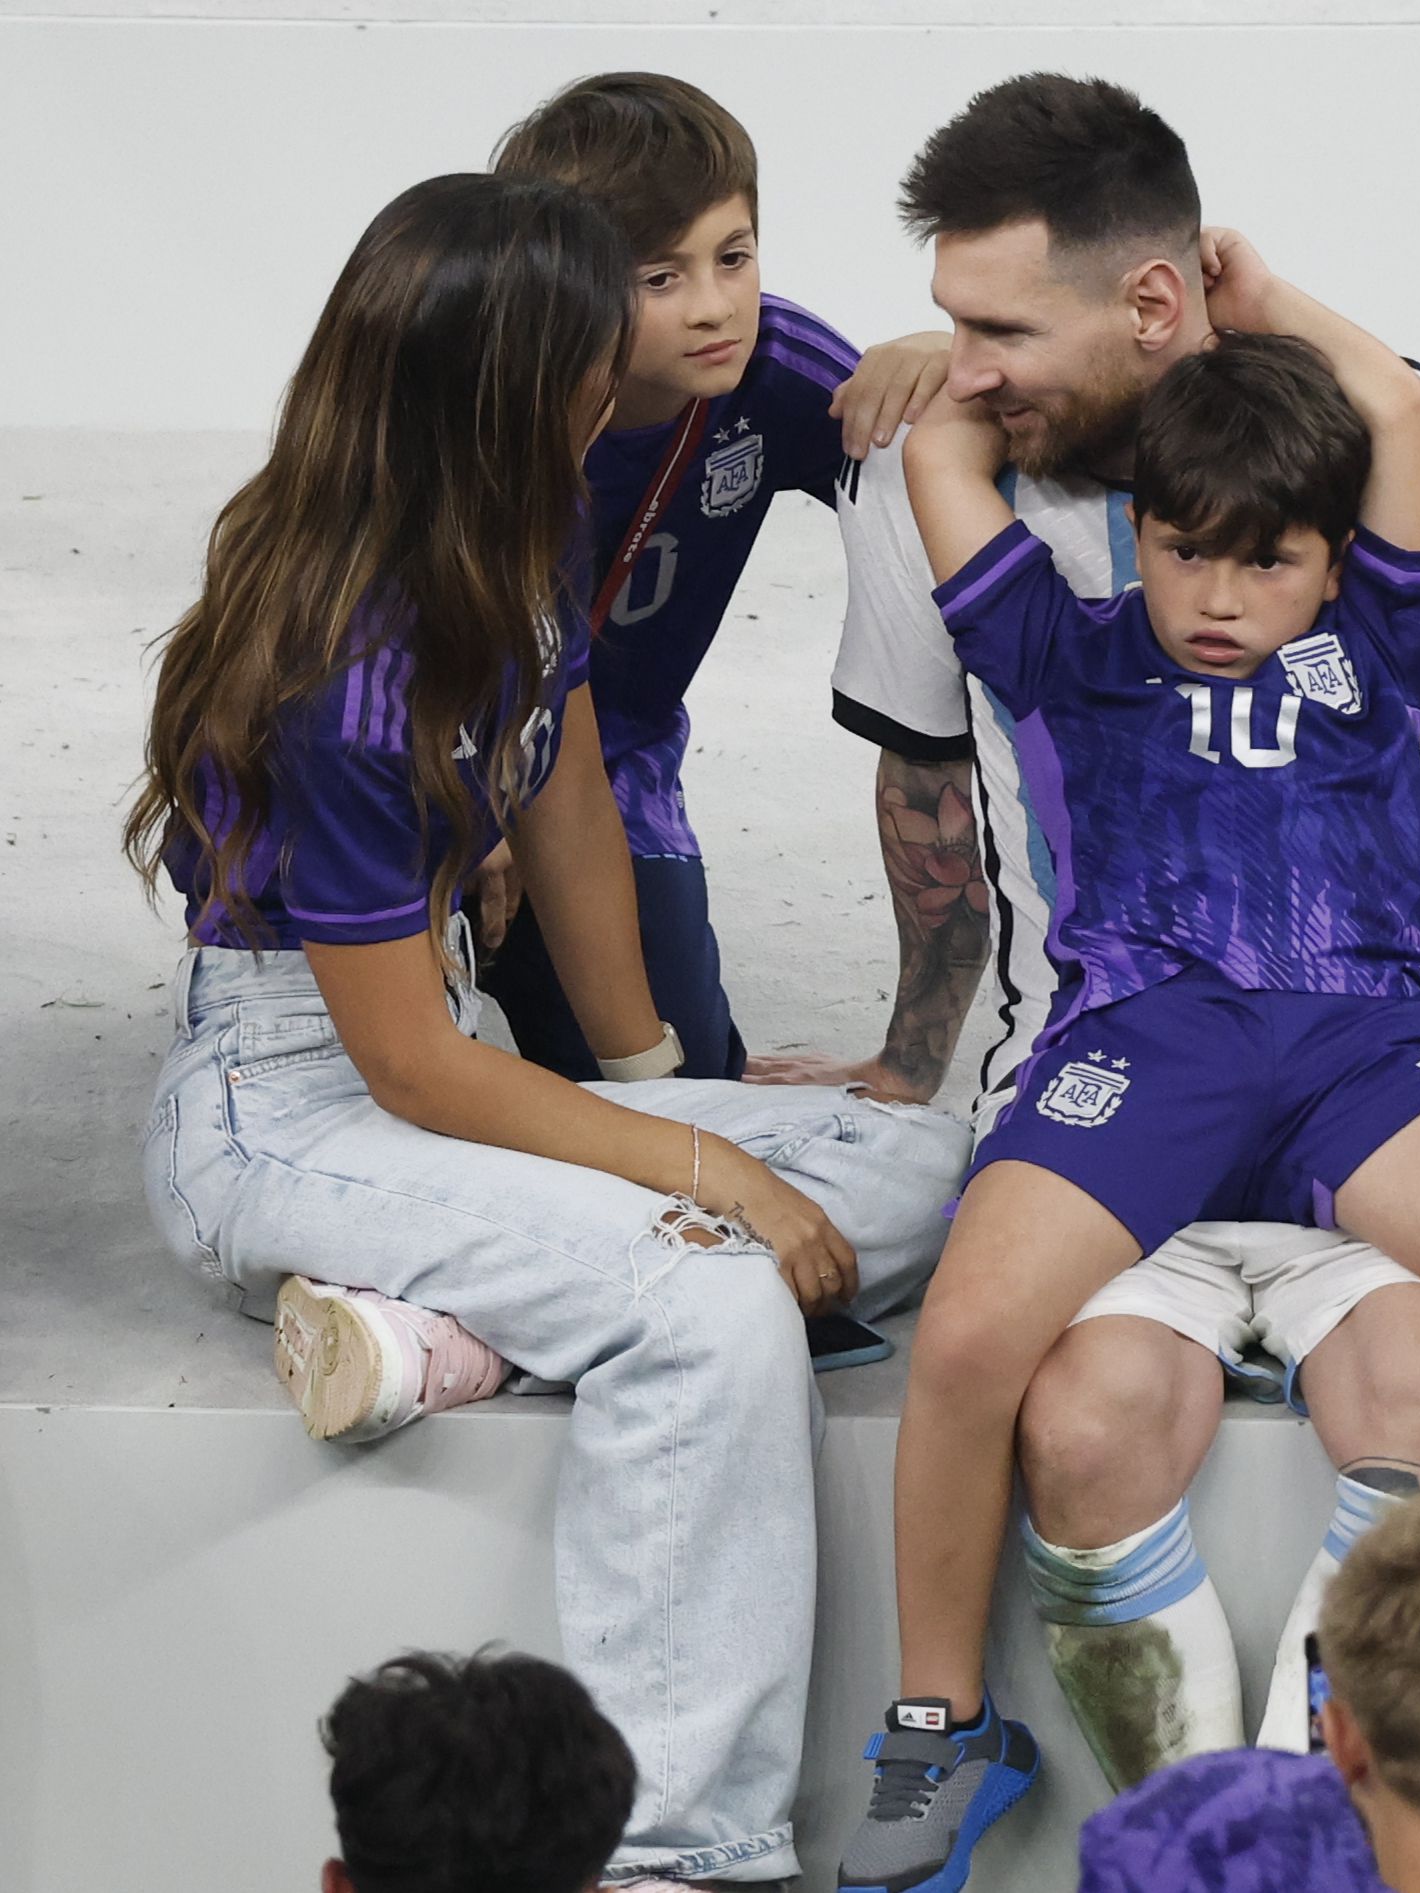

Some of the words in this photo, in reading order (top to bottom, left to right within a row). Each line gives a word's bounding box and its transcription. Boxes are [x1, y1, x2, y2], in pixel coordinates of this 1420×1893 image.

[716, 462, 749, 494] AFA
[1304, 659, 1343, 696] AFA
[1174, 683, 1302, 768] 10
[1060, 1079, 1103, 1109] AFA
